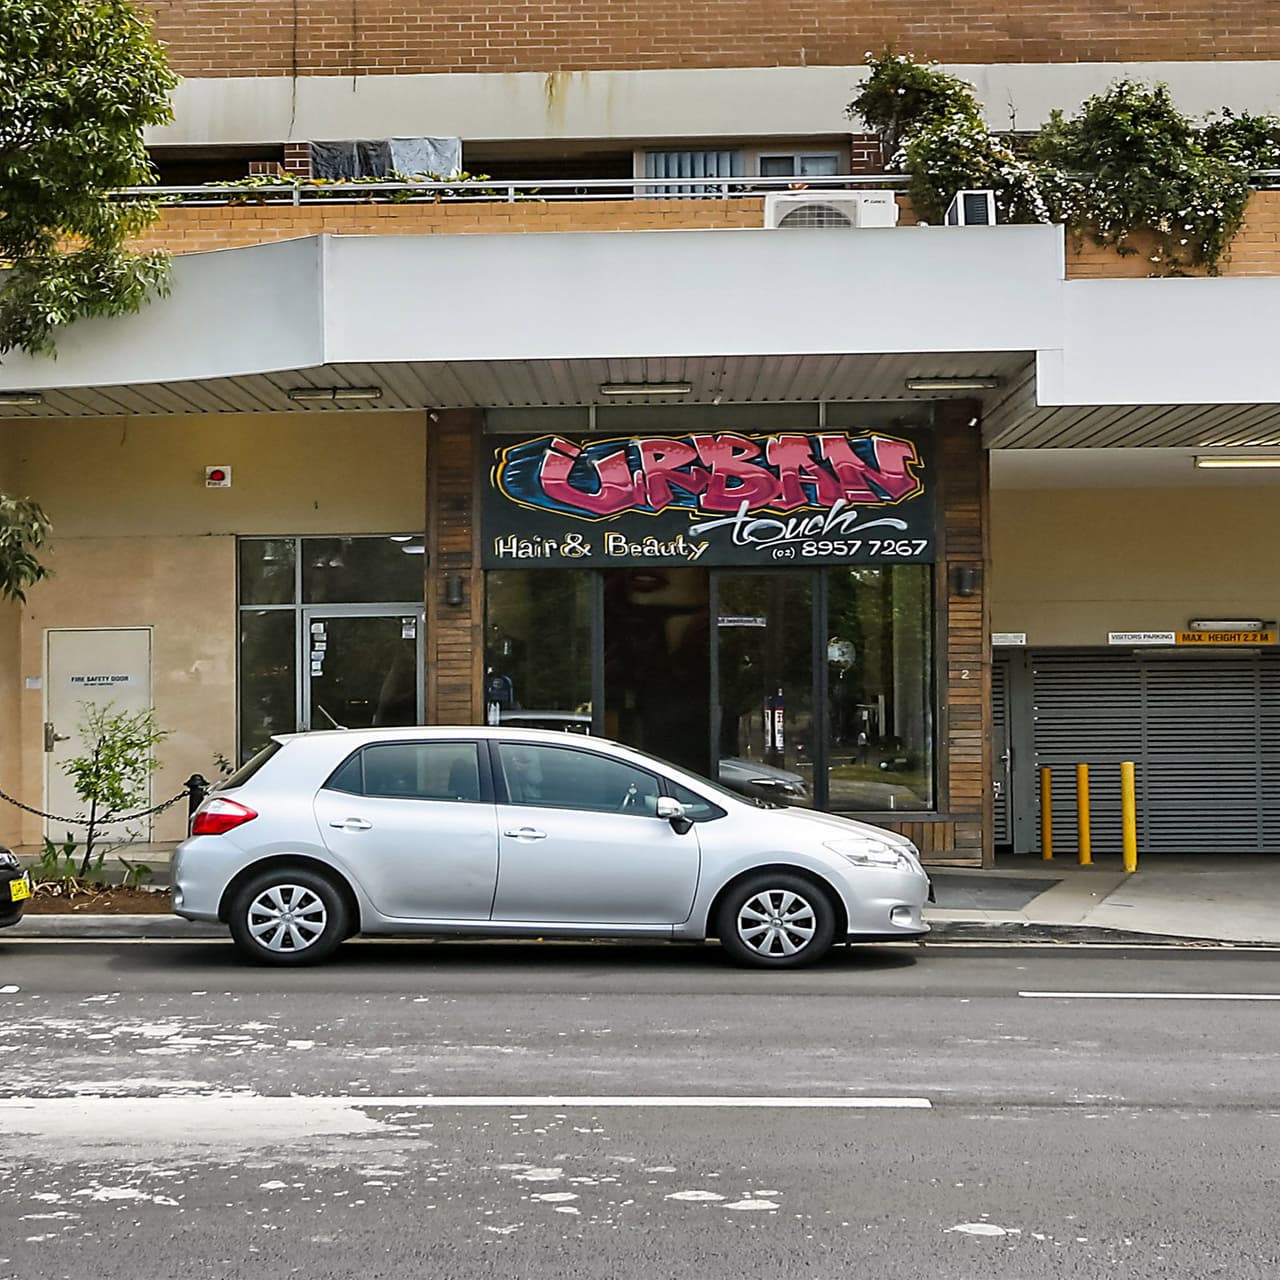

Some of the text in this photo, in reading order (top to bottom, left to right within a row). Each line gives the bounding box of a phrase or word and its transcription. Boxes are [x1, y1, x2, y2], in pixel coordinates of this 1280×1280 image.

[539, 434, 918, 516] URBAN
[689, 498, 908, 551] touch
[494, 532, 710, 560] Hair & Beauty
[772, 540, 928, 560] (02) 8957 7267
[1208, 633, 1241, 642] HEIGHT
[1243, 633, 1258, 642] 2.2
[961, 669, 970, 680] 2
